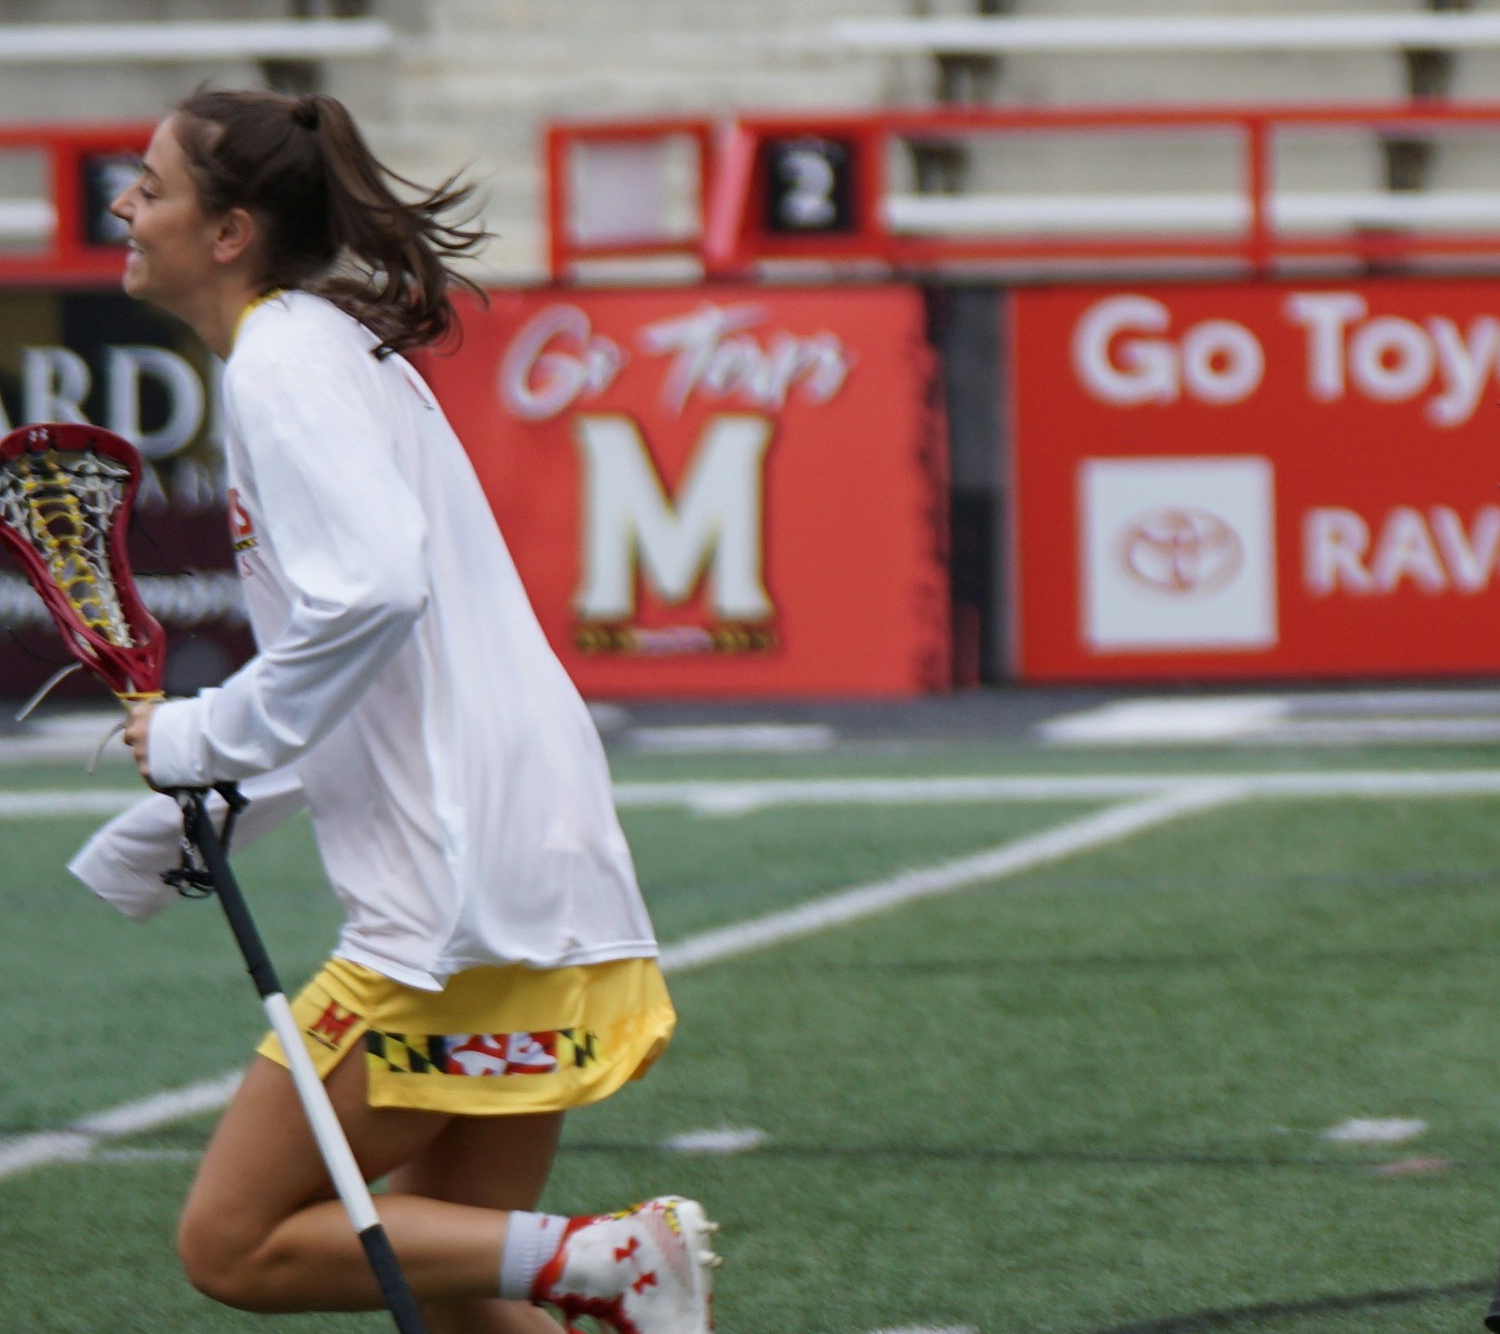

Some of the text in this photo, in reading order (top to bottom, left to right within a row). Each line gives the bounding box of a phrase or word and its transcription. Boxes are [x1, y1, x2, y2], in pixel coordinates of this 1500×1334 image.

[500, 303, 628, 422] Go
[1073, 293, 1265, 404] Go
[573, 412, 778, 622] M
[310, 1000, 363, 1045] M
